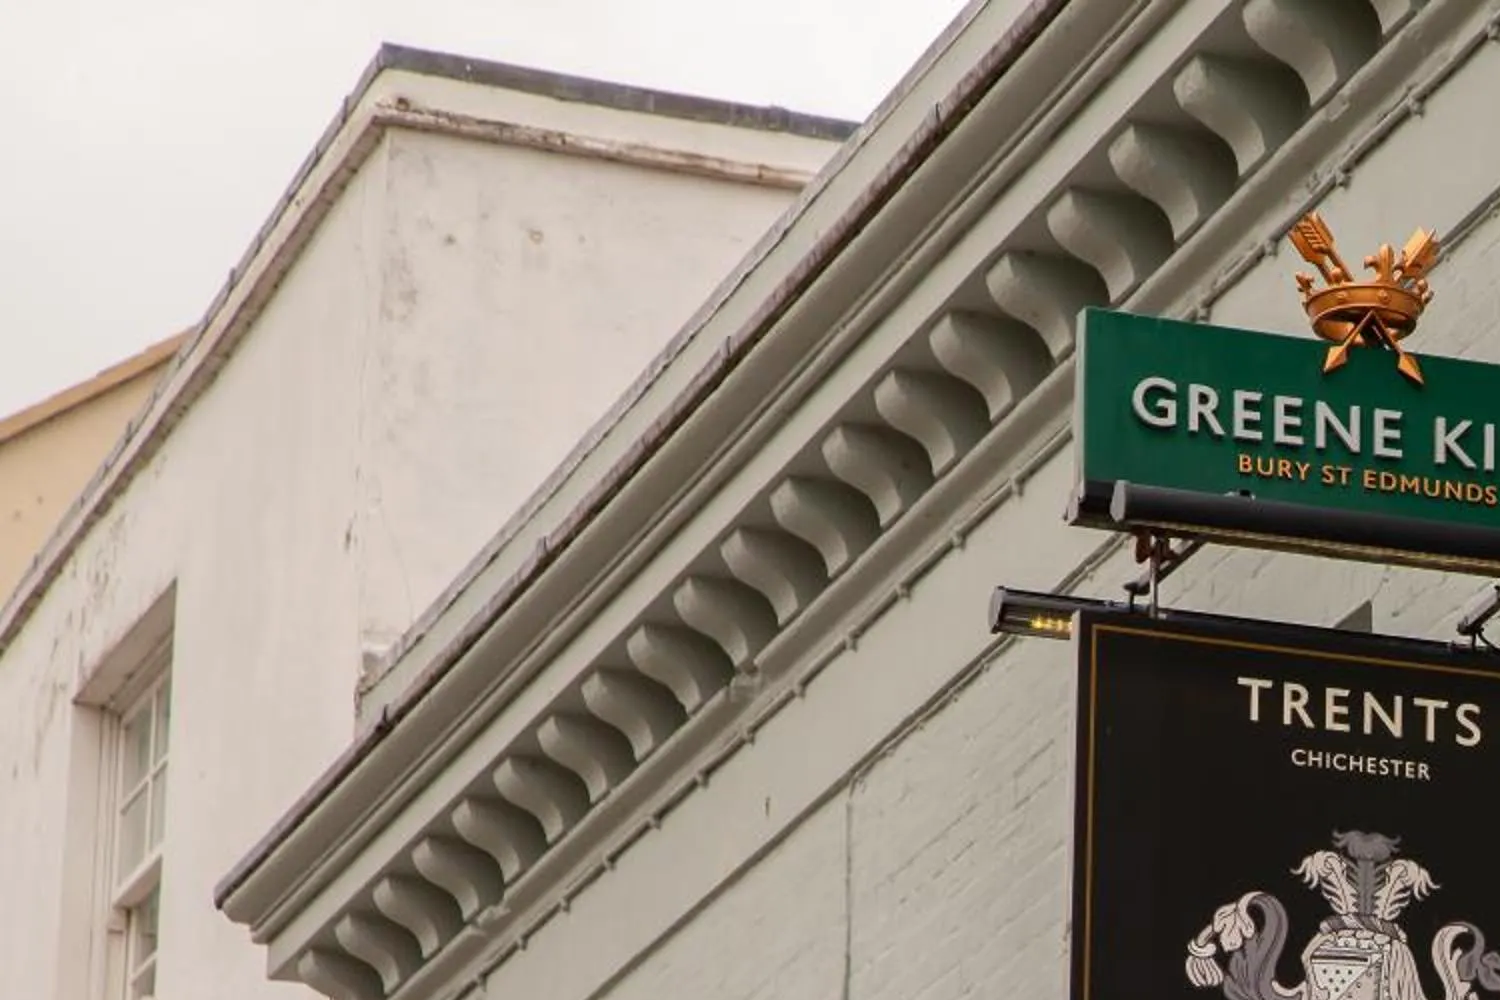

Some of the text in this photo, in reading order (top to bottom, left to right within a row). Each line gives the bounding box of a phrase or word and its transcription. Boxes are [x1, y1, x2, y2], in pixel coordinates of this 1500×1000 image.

[1131, 376, 1403, 459] GREENE
[1238, 453, 1499, 506] BURY ST EDMUNDS
[1237, 676, 1483, 748] TRENTS
[1290, 748, 1431, 782] CHICHESTER
